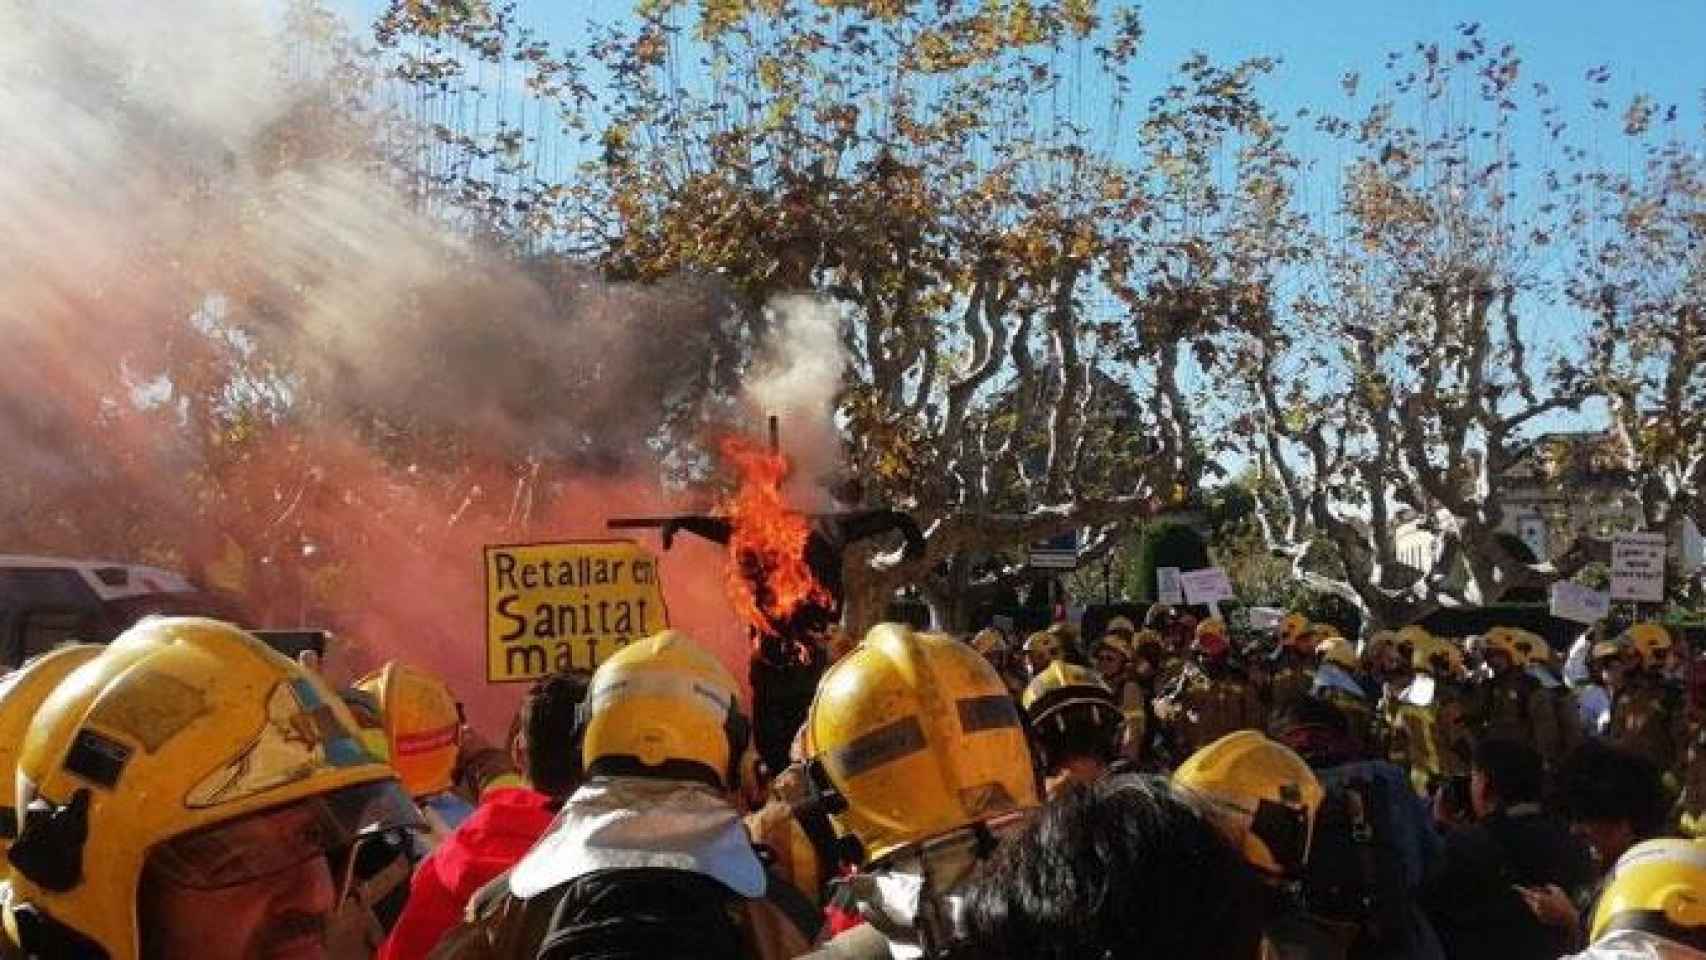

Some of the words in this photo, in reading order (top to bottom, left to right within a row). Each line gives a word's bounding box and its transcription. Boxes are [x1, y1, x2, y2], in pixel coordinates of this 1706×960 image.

[496, 553, 624, 590] Retallar
[497, 594, 650, 640] Sanitat
[506, 637, 631, 674] mat
